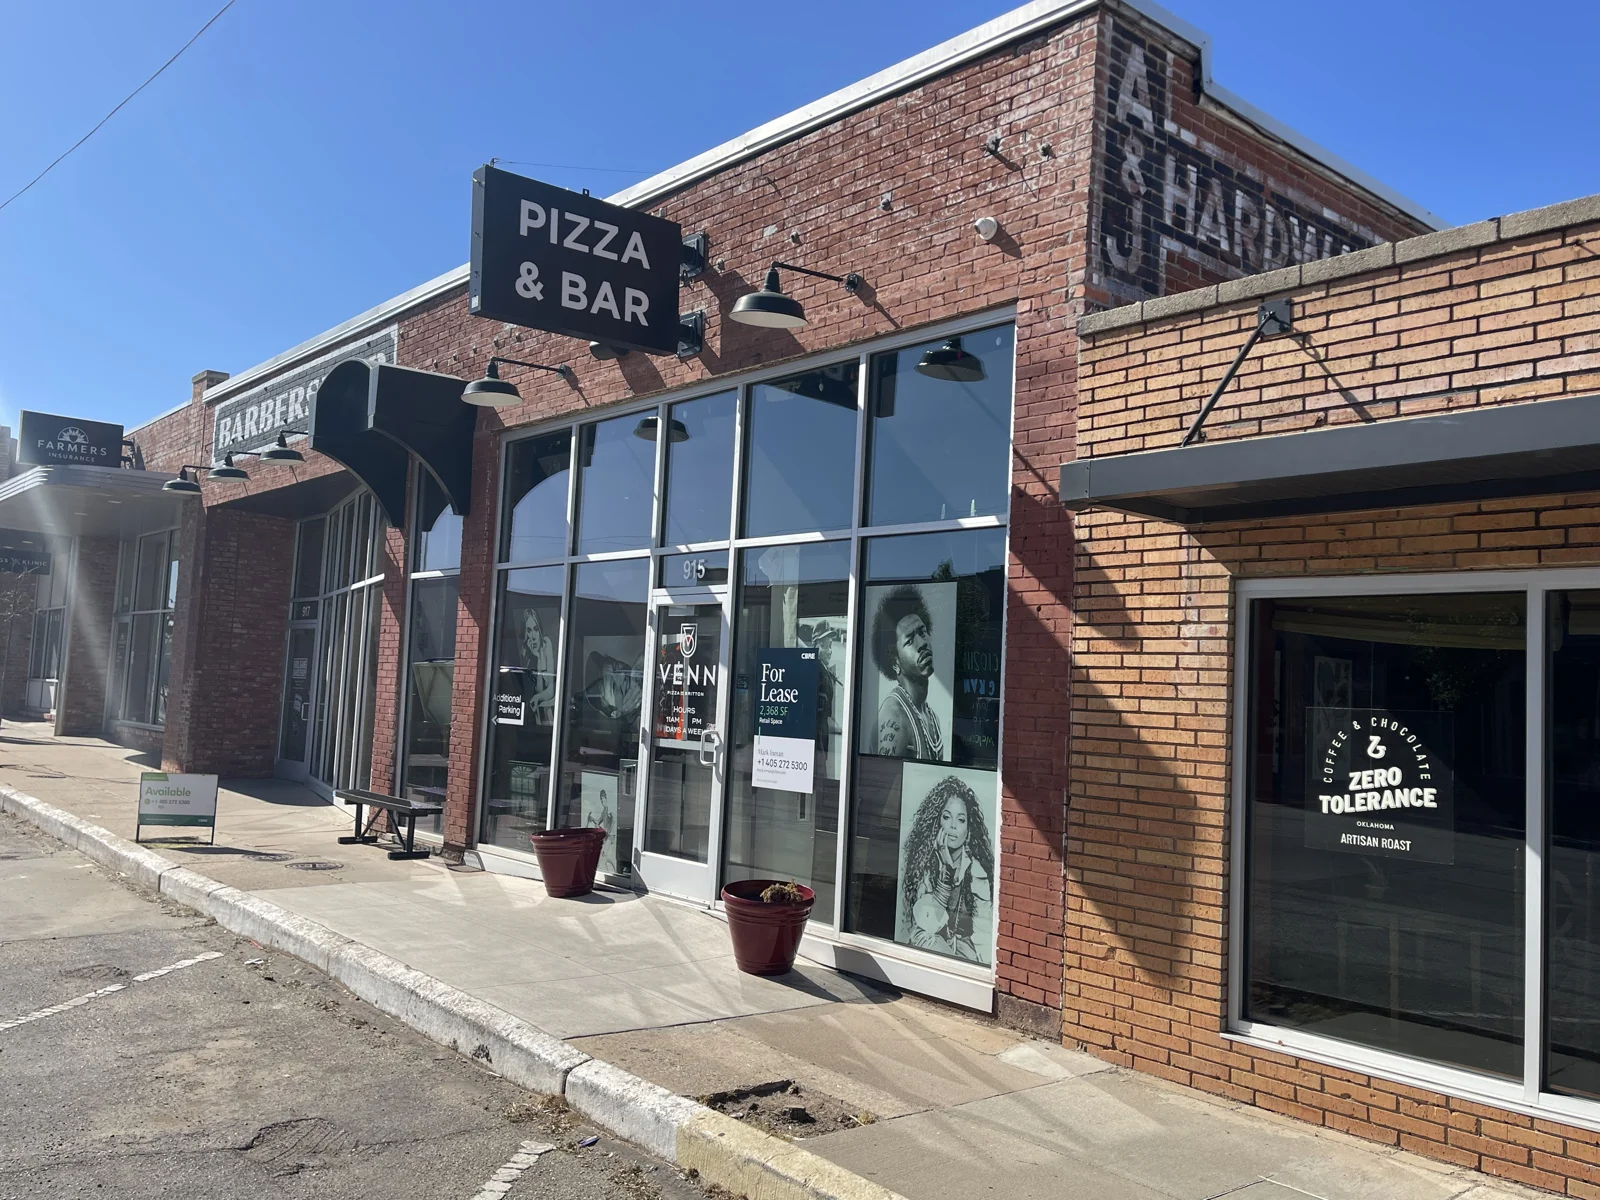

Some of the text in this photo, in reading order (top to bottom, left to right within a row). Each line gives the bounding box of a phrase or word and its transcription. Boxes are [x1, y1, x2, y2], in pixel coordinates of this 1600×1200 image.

[519, 199, 650, 270] PIZZA
[515, 261, 650, 327] & BAR
[218, 376, 326, 449] BARBERS
[37, 439, 107, 456] FARMERS
[48, 452, 95, 463] INSURANCE
[683, 559, 705, 580] 915
[302, 605, 311, 617] 917
[761, 663, 785, 683] For
[492, 693, 521, 704] Additional
[760, 683, 799, 703] Lease
[499, 704, 520, 717] Parking
[673, 706, 696, 715] HOURS
[759, 705, 788, 717] 2,368 SF
[691, 717, 702, 725] PM
[770, 718, 783, 726] Space
[1323, 717, 1431, 784] COFFEE & CHOCOLATE
[765, 758, 778, 768] 405
[778, 759, 790, 770] 272
[791, 760, 808, 771] 5300
[1348, 766, 1403, 791] ZERO
[145, 786, 191, 797] Available
[1318, 787, 1438, 815] TOLERANCE
[1356, 820, 1395, 831] OKLAHOMA
[1340, 833, 1412, 852] ARTISAN ROAST
